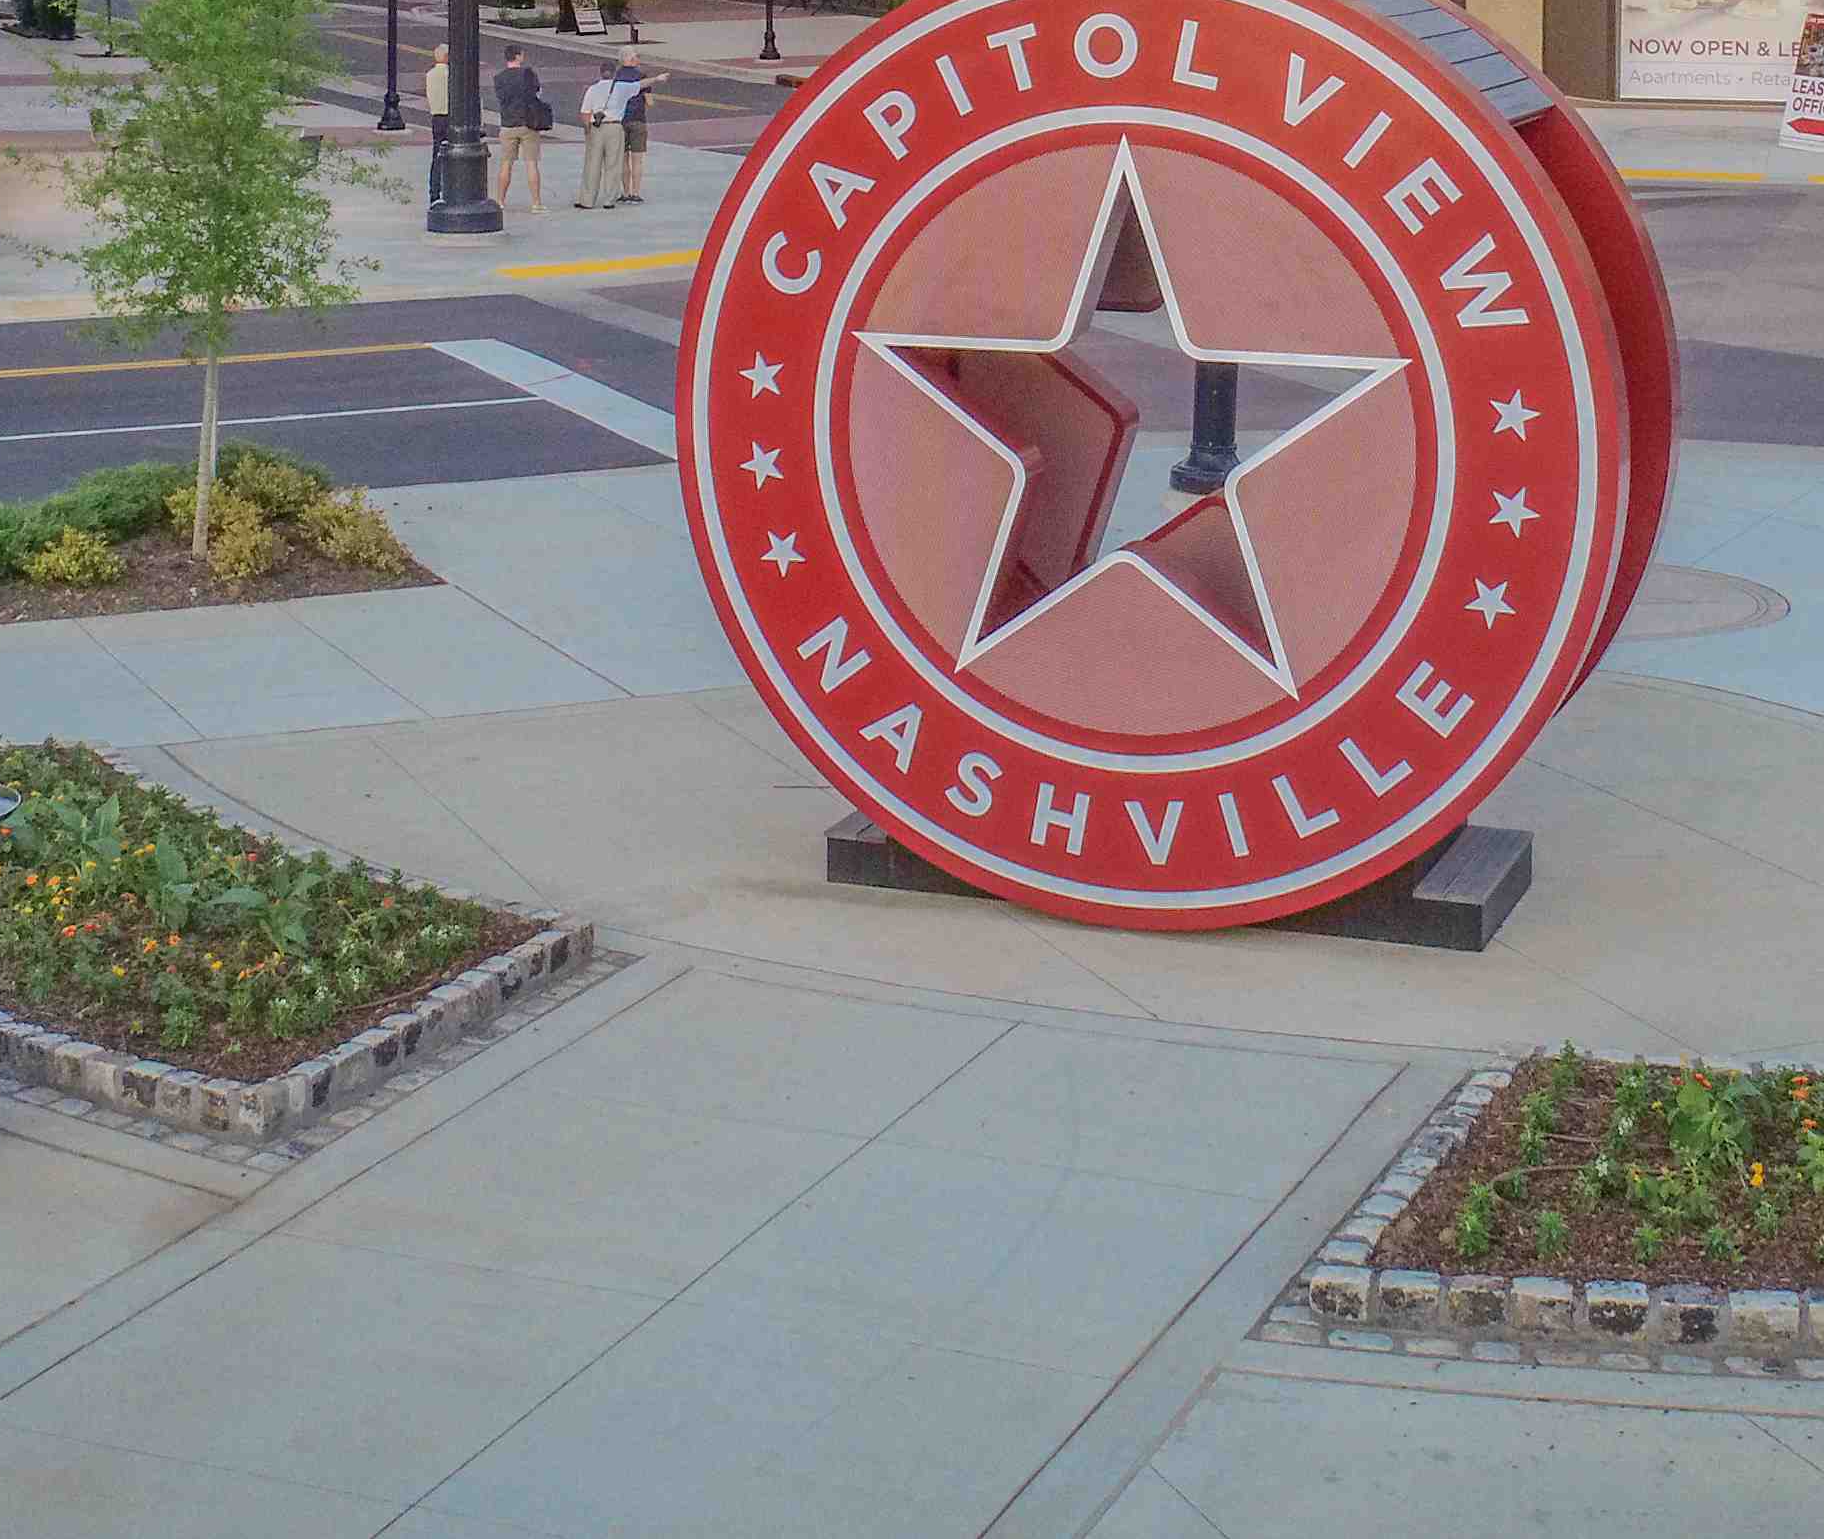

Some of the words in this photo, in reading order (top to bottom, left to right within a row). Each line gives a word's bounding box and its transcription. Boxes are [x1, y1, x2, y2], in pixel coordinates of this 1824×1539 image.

[1628, 68, 1732, 89] Apartments
[1629, 38, 1683, 55] NOW
[1690, 39, 1749, 57] OPEN
[1756, 40, 1771, 57] &
[762, 10, 1226, 298] CAPITOL
[1278, 51, 1531, 331] VIEW
[797, 659, 1473, 867] NASHVILLE
